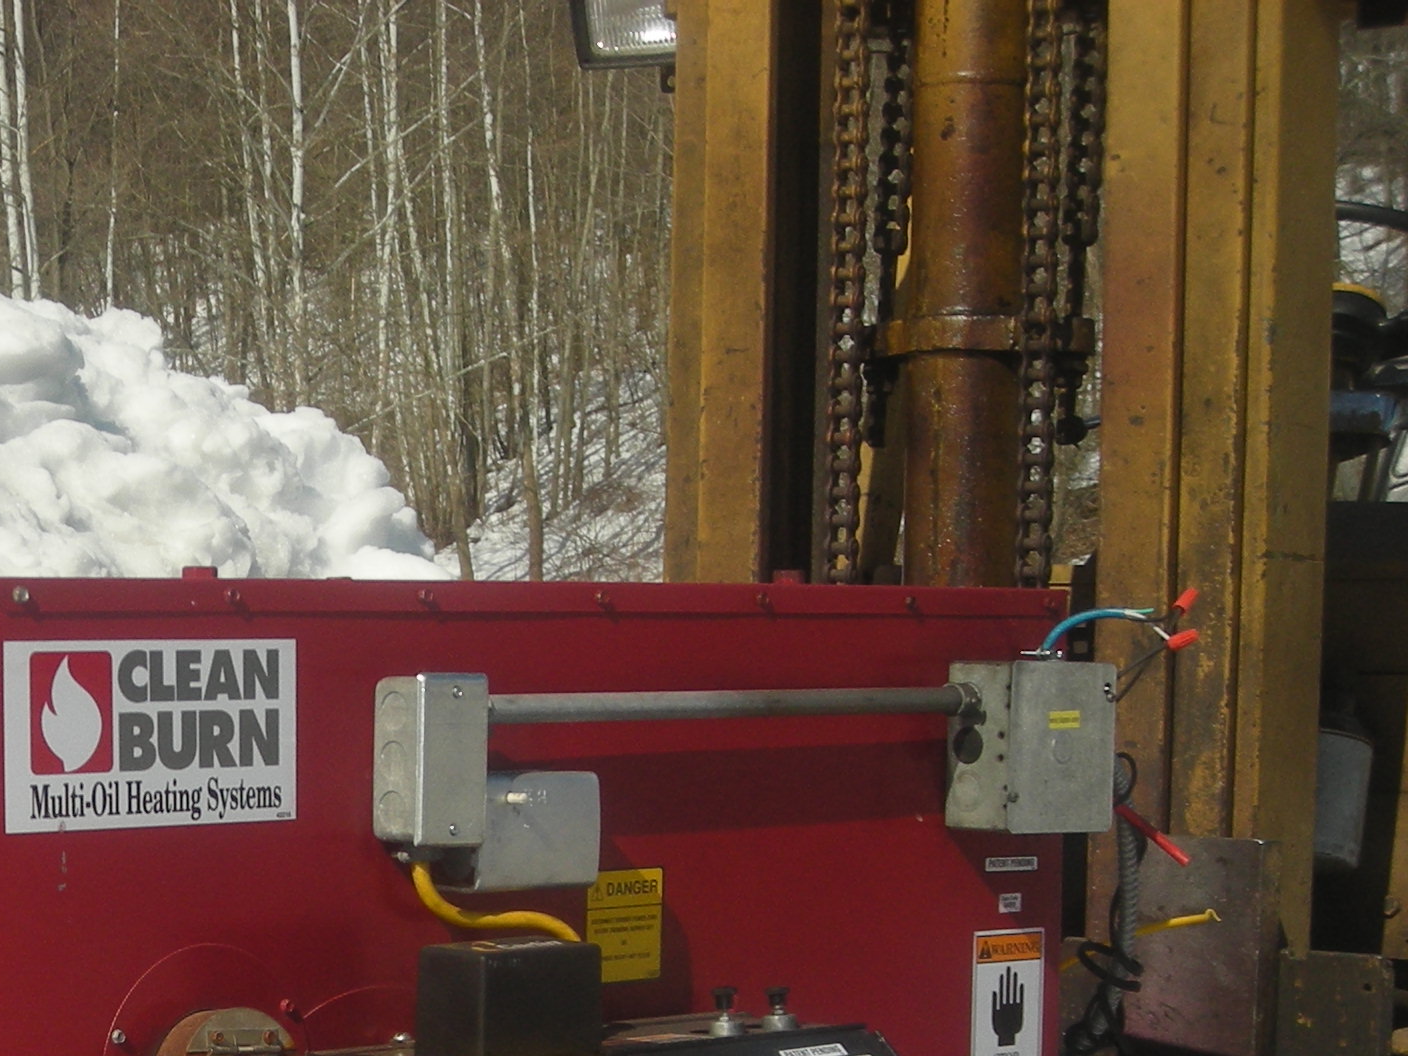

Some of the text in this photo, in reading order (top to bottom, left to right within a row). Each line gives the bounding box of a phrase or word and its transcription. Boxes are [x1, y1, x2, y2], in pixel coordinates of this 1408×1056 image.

[117, 648, 279, 703] CLEAN
[118, 708, 280, 772] BURN
[30, 776, 283, 821] Multi-Oil Heating Systems
[607, 879, 658, 897] DANGER
